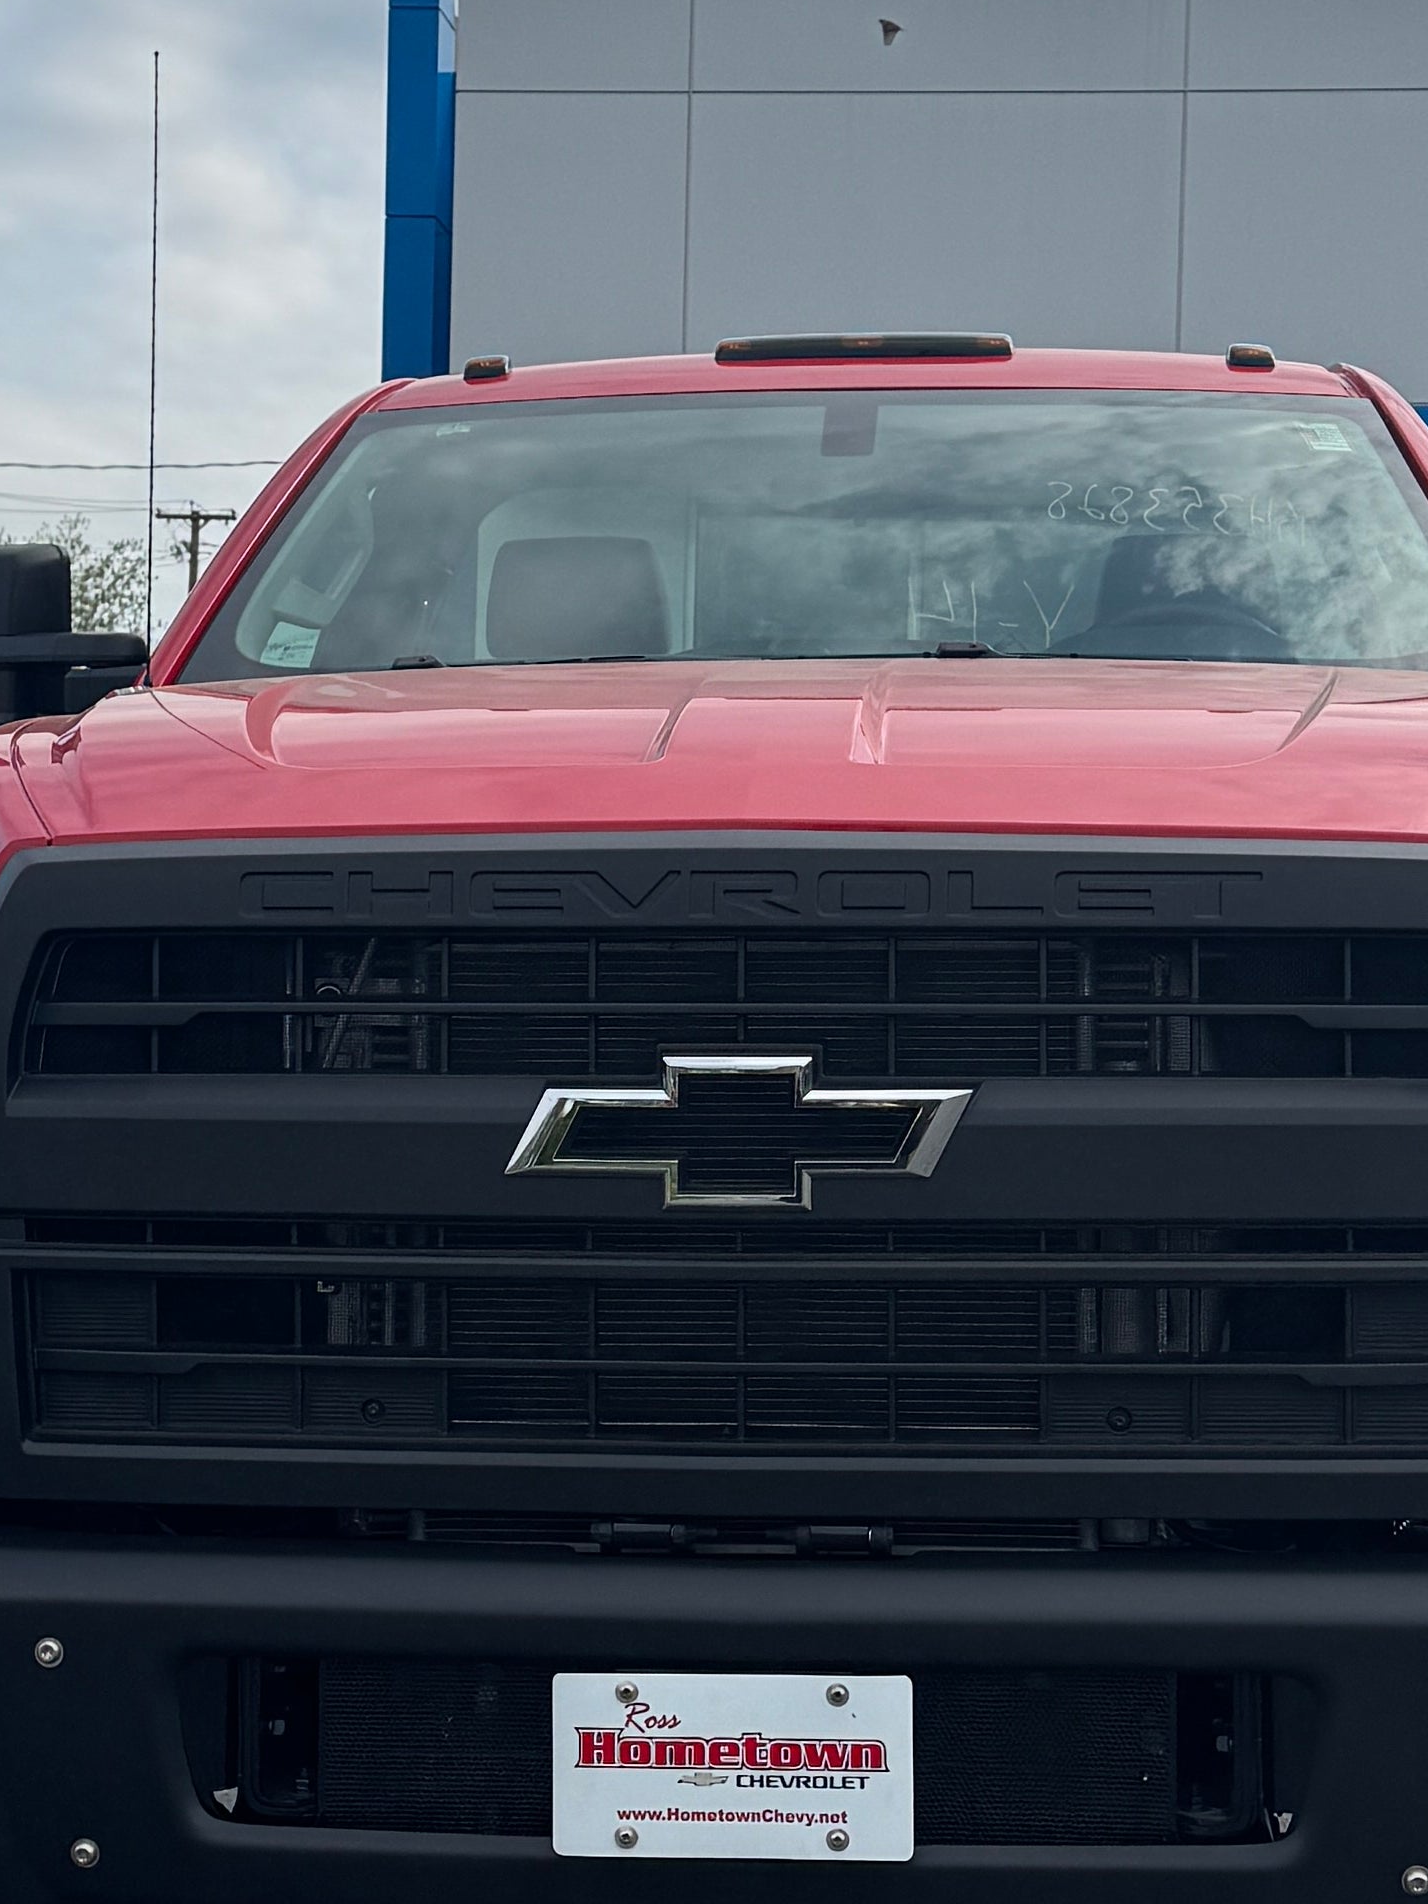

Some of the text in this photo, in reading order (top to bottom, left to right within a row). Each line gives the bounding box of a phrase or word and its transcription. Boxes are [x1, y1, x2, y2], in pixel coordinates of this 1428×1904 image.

[236, 868, 1265, 919] CHEVROLET
[624, 1702, 682, 1733] Ross
[574, 1726, 890, 1773] Hometown
[736, 1774, 871, 1790] CHEVROLET
[616, 1807, 848, 1827] www.HometownChevy.net
